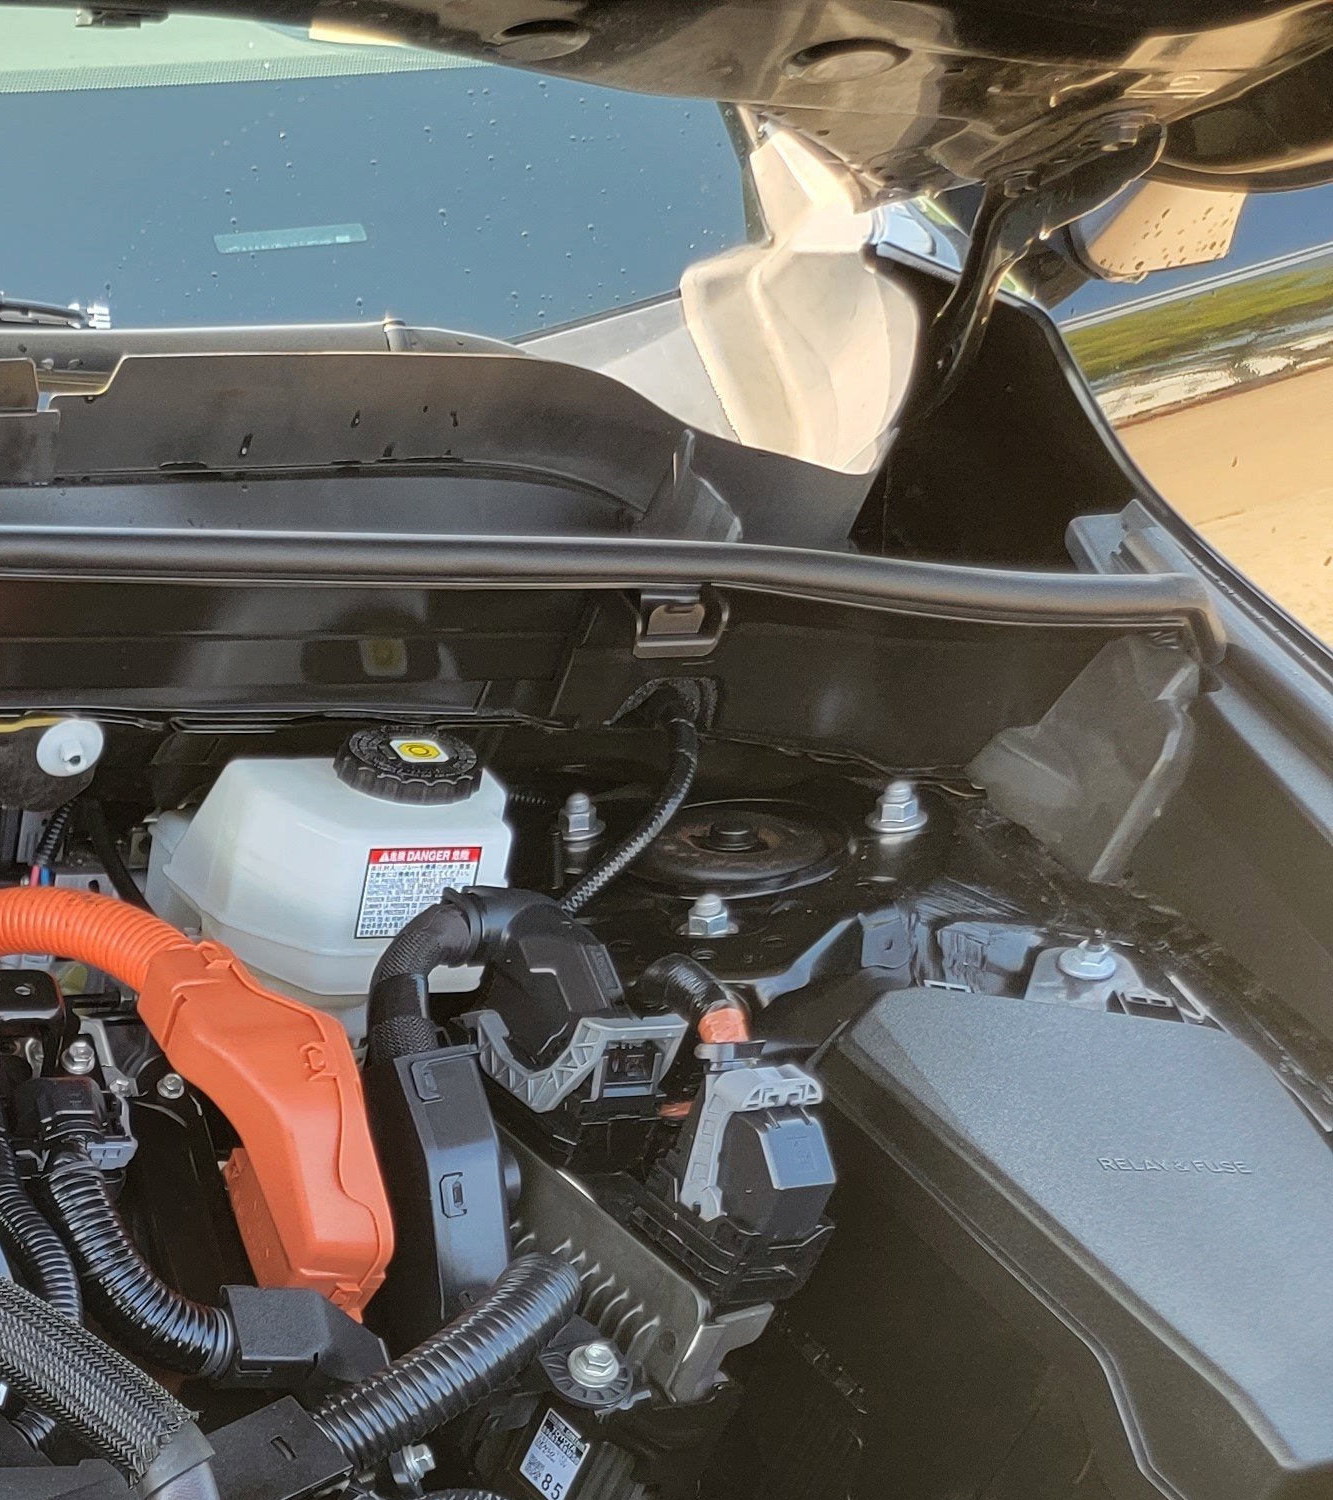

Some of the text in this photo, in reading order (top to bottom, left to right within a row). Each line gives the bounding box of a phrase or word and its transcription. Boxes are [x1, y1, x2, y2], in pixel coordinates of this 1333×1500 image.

[407, 850, 450, 862] DANGER
[1096, 1157, 1169, 1172] RELAY
[1192, 1160, 1253, 1174] FUSE
[552, 1426, 578, 1453] TOYOTA
[541, 1473, 564, 1500] 85
